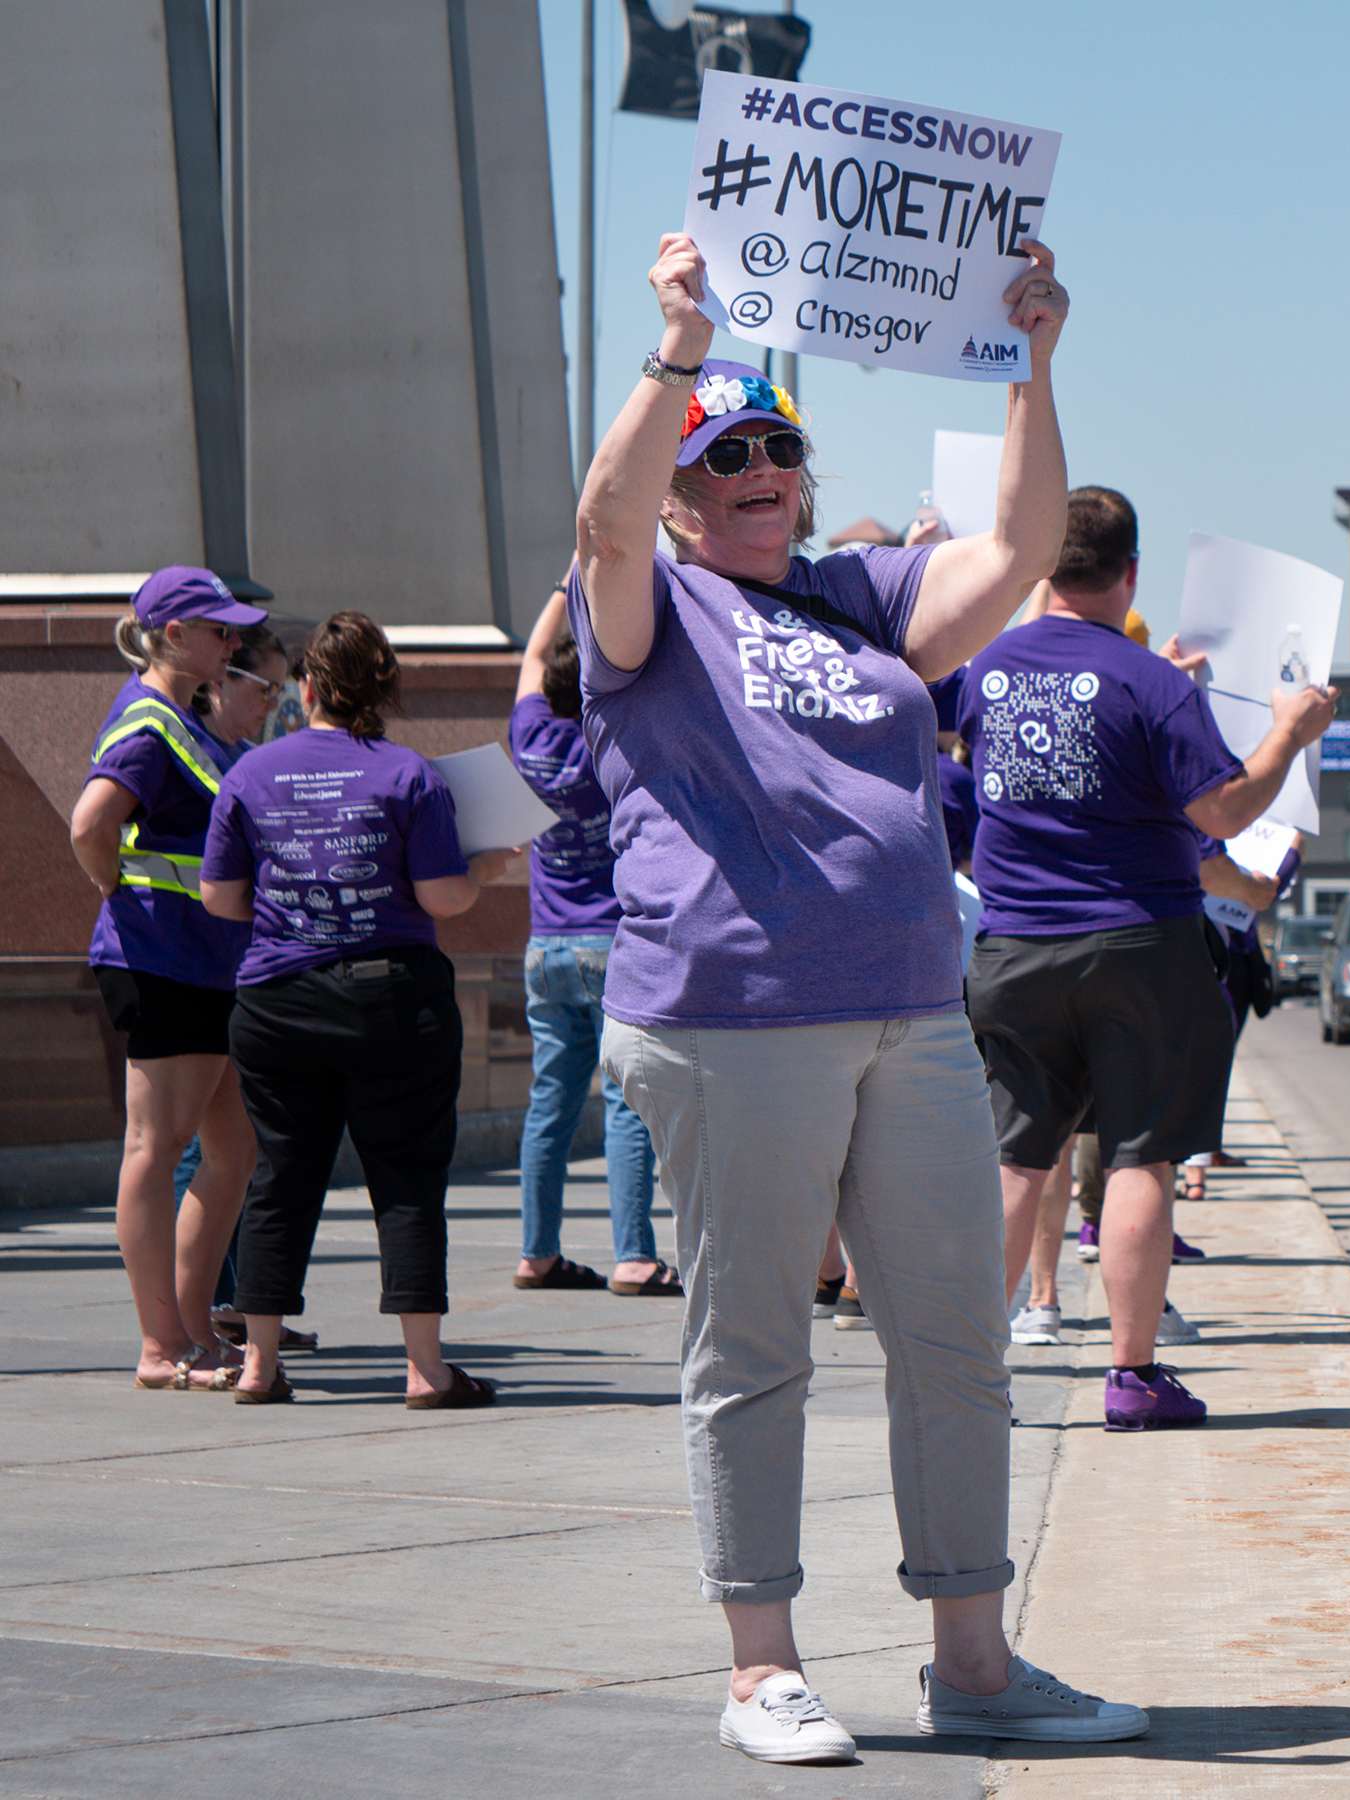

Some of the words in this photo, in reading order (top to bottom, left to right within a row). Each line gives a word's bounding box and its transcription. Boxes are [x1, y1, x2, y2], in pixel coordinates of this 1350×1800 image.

[741, 87, 1033, 167] #ACCESSNOW
[980, 342, 1018, 361] AIM
[824, 657, 861, 693] &
[743, 673, 824, 718] End
